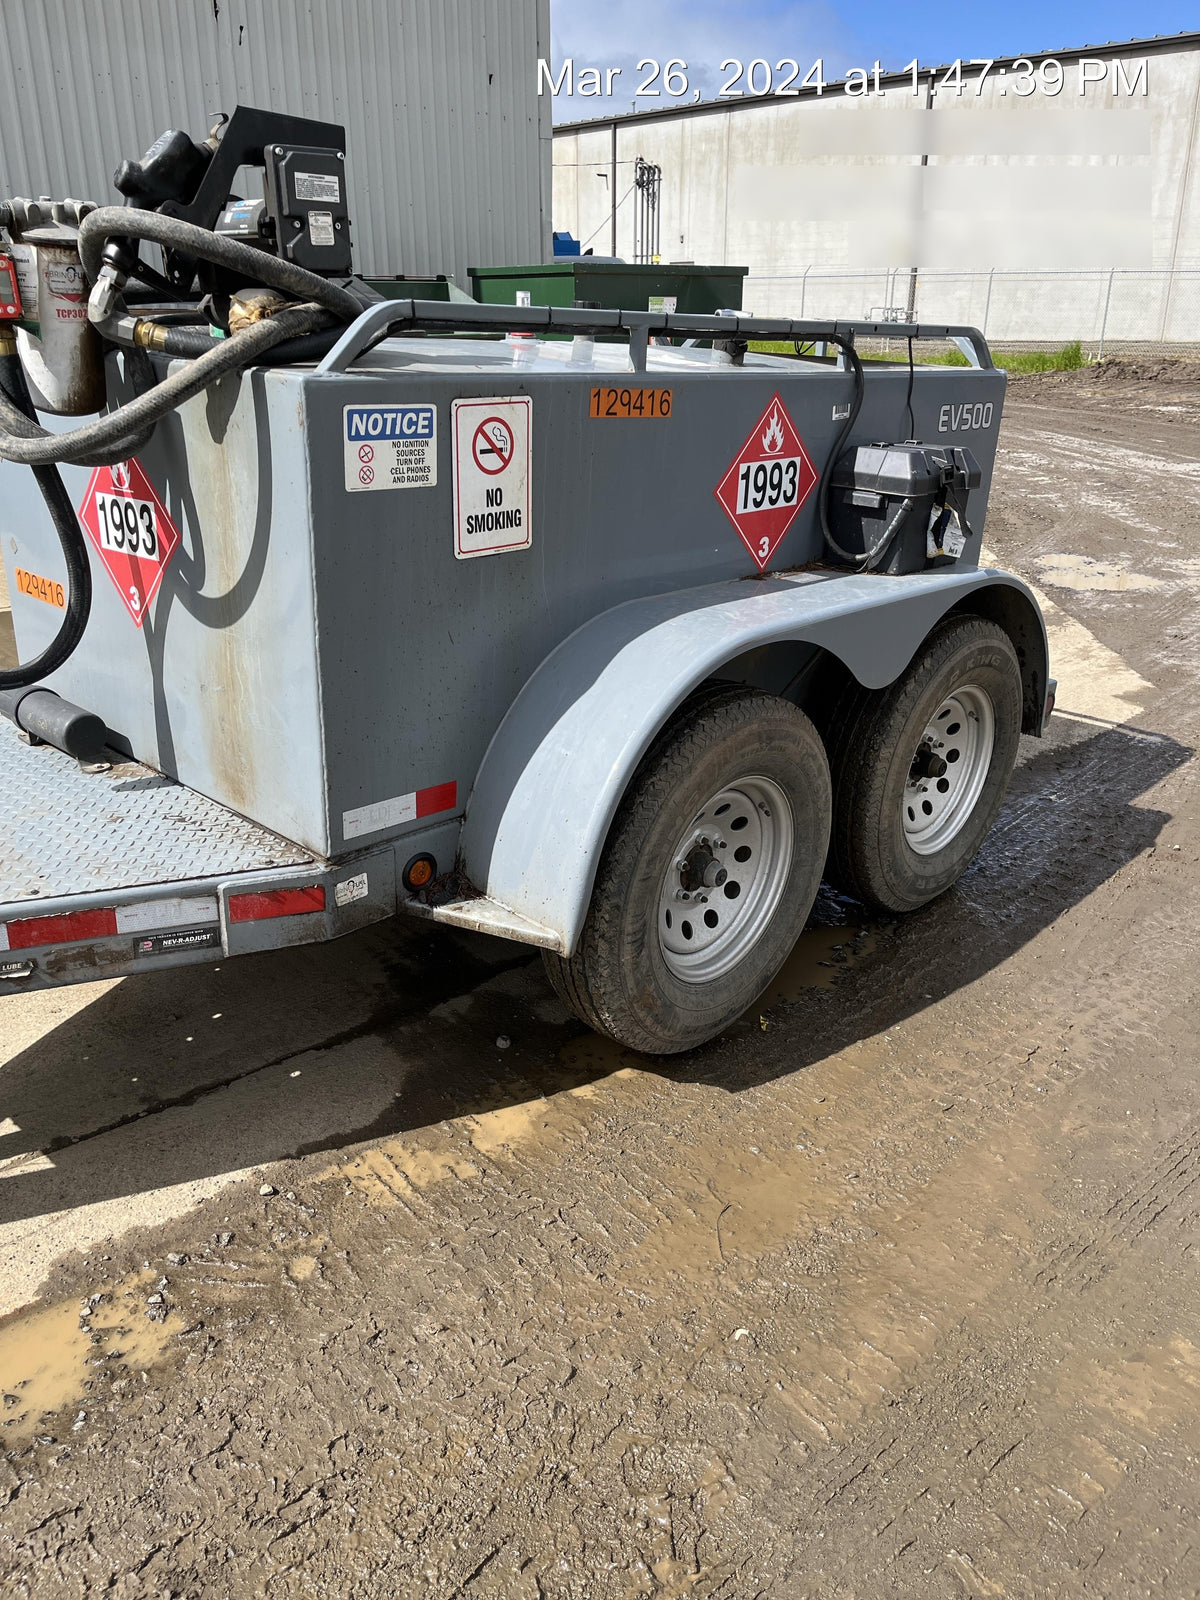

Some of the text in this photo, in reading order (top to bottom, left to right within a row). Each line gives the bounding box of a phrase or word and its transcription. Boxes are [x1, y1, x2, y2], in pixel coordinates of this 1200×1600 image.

[593, 388, 671, 416] 129416
[350, 412, 432, 436] NOTICE
[938, 402, 994, 432] EV500
[391, 440, 430, 449] NO IGNITION
[396, 449, 425, 457] SOURCES
[390, 466, 431, 475] CELL PHONES
[396, 457, 426, 466] TURN OFF
[392, 474, 430, 484] AND RADIOS
[740, 460, 798, 510] 1993
[485, 487, 503, 508] NO
[99, 496, 156, 557] 1993
[466, 508, 522, 534] SMOKING
[758, 536, 770, 558] 3
[17, 569, 64, 607] 129416
[129, 585, 141, 611] 3
[162, 934, 211, 946] NEV-R-ADJUST
